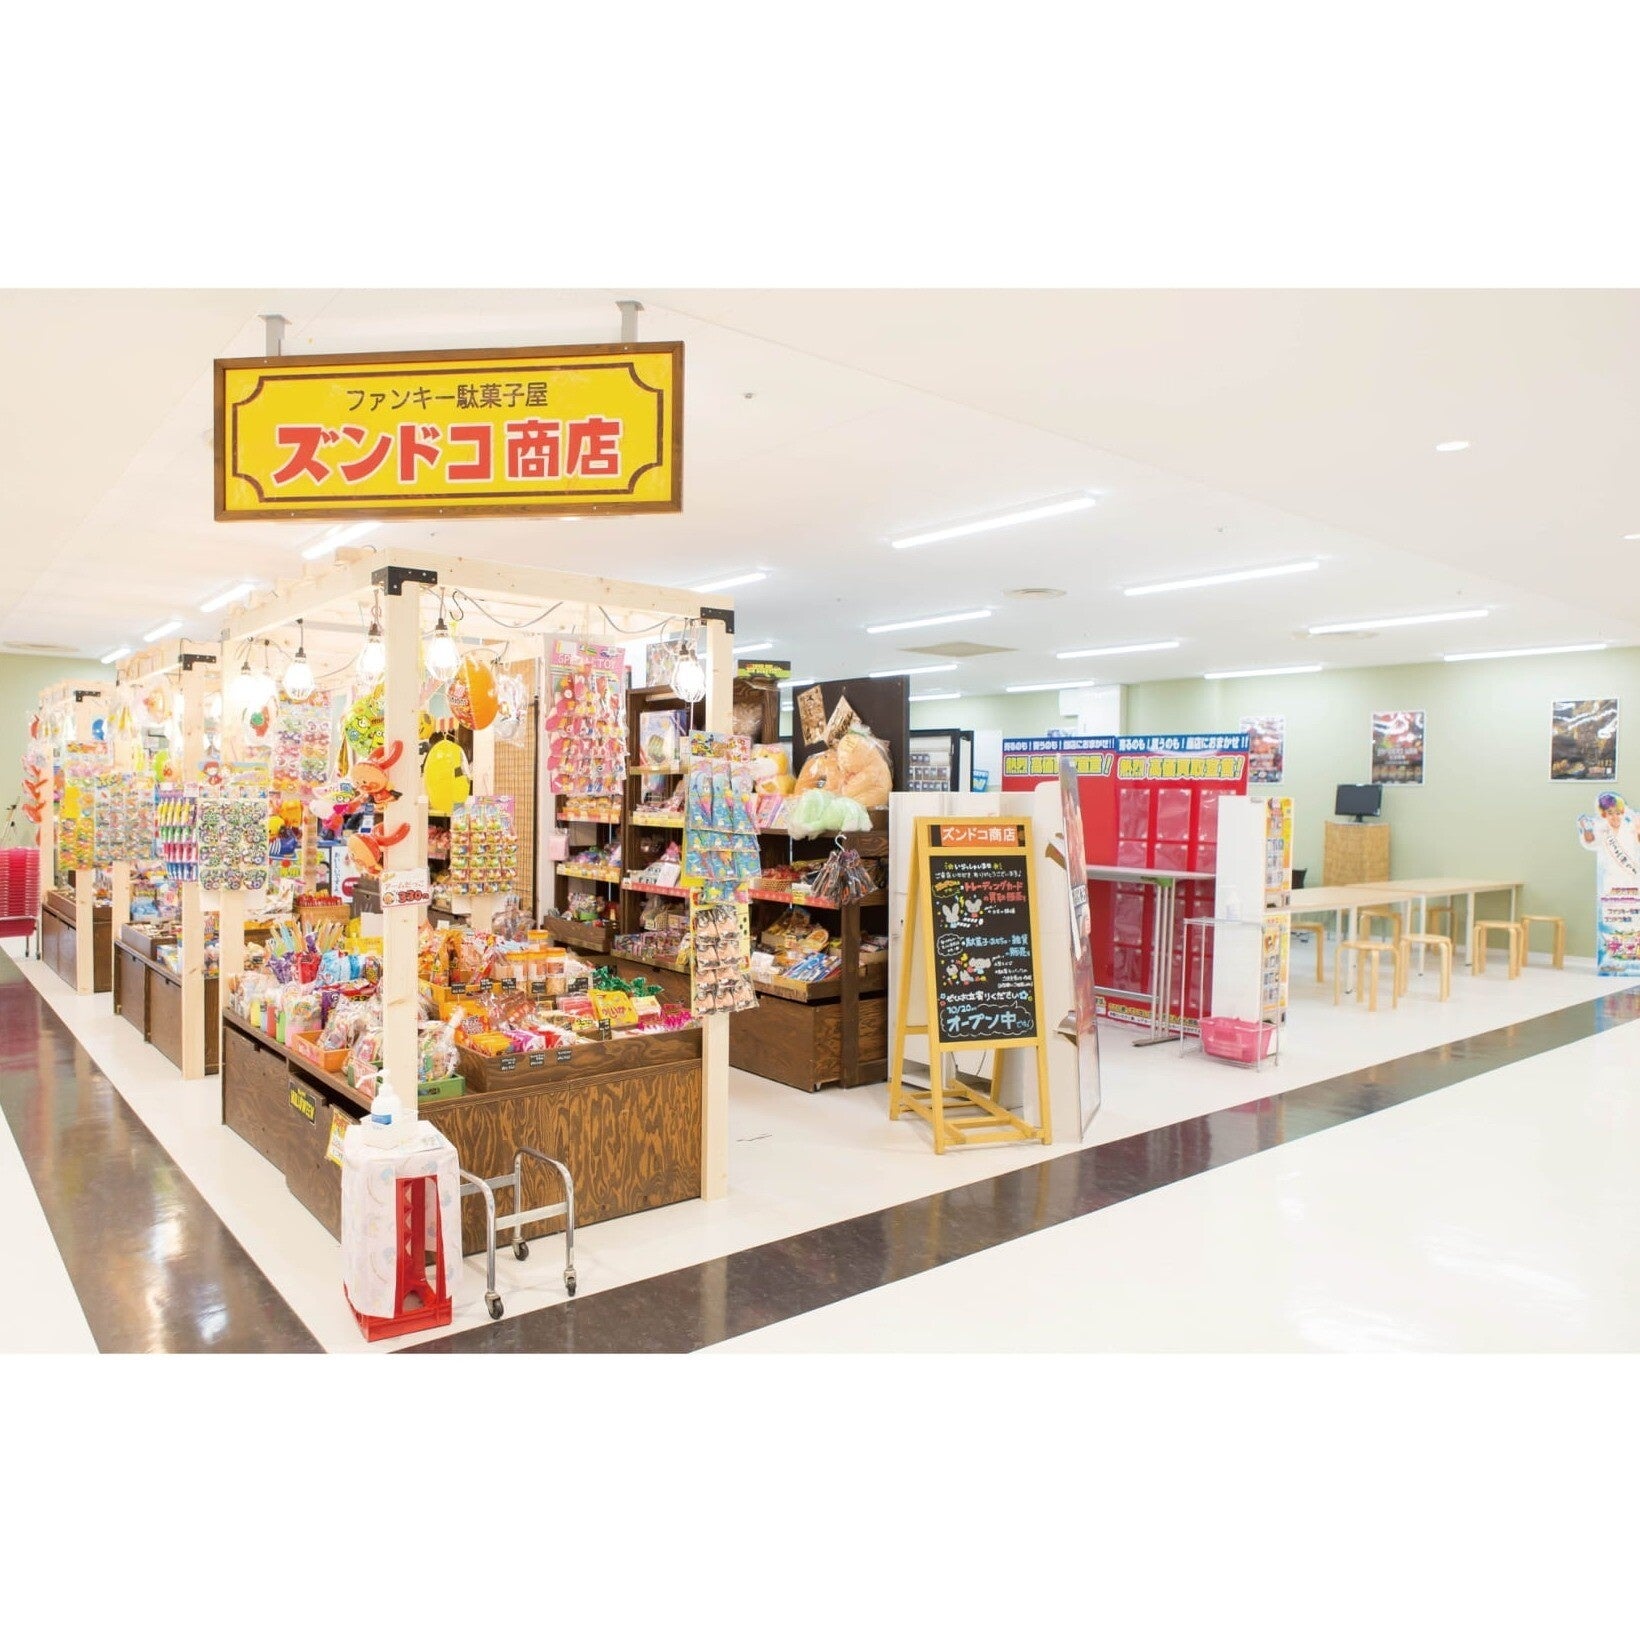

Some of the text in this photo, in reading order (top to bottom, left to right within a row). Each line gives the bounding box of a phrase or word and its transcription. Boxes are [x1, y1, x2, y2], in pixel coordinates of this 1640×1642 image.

[347, 382, 549, 412] ファンキー駄菓子屋
[272, 417, 623, 485] ズンドコ商店
[942, 827, 1017, 842] ズンドコ商店
[963, 880, 1024, 892] トレーディングカード
